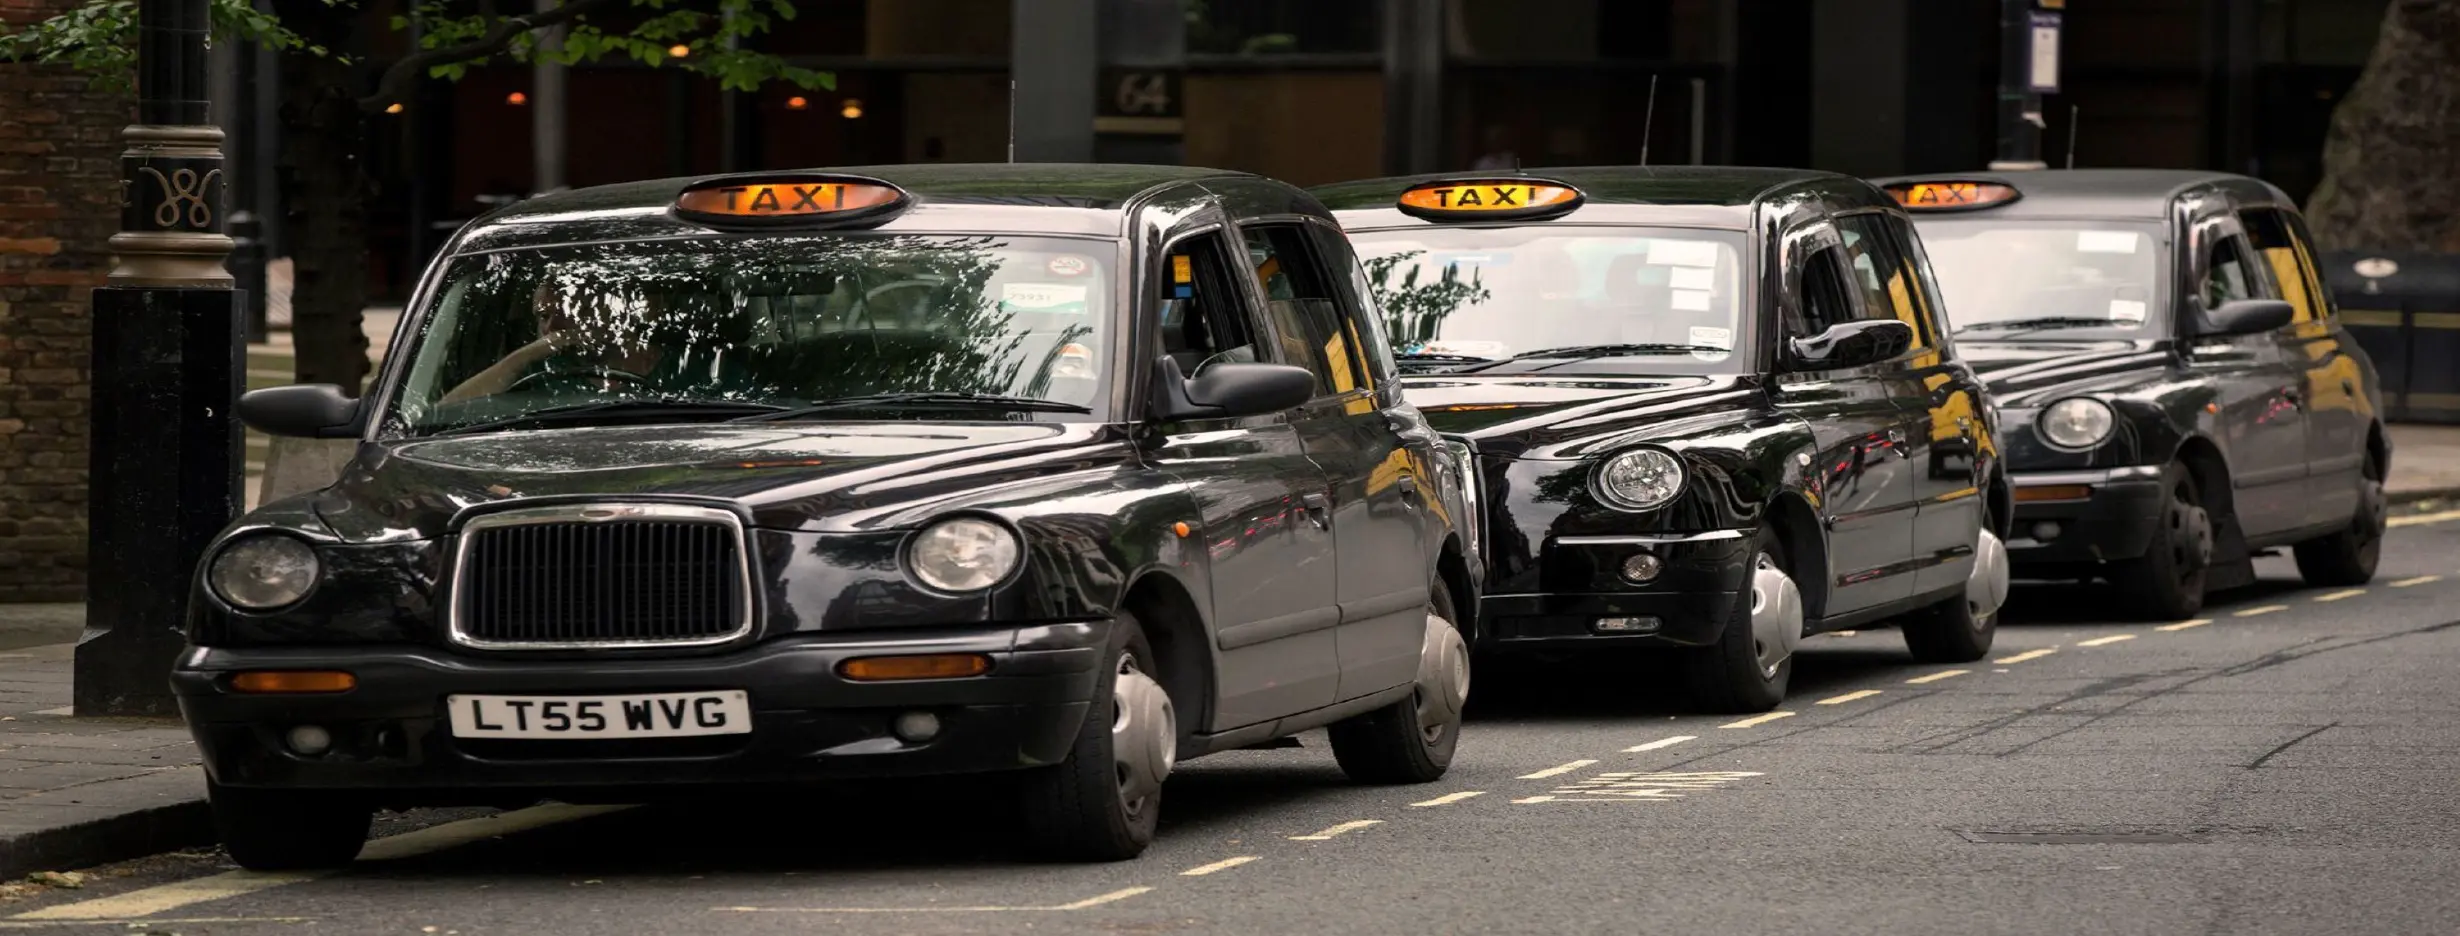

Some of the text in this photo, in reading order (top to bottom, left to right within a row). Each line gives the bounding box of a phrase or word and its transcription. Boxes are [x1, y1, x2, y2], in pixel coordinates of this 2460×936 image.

[1116, 72, 1171, 114] 64
[720, 185, 845, 212] TAXI
[1433, 187, 1536, 207] TAXI
[471, 697, 727, 732] LT55 WVG
